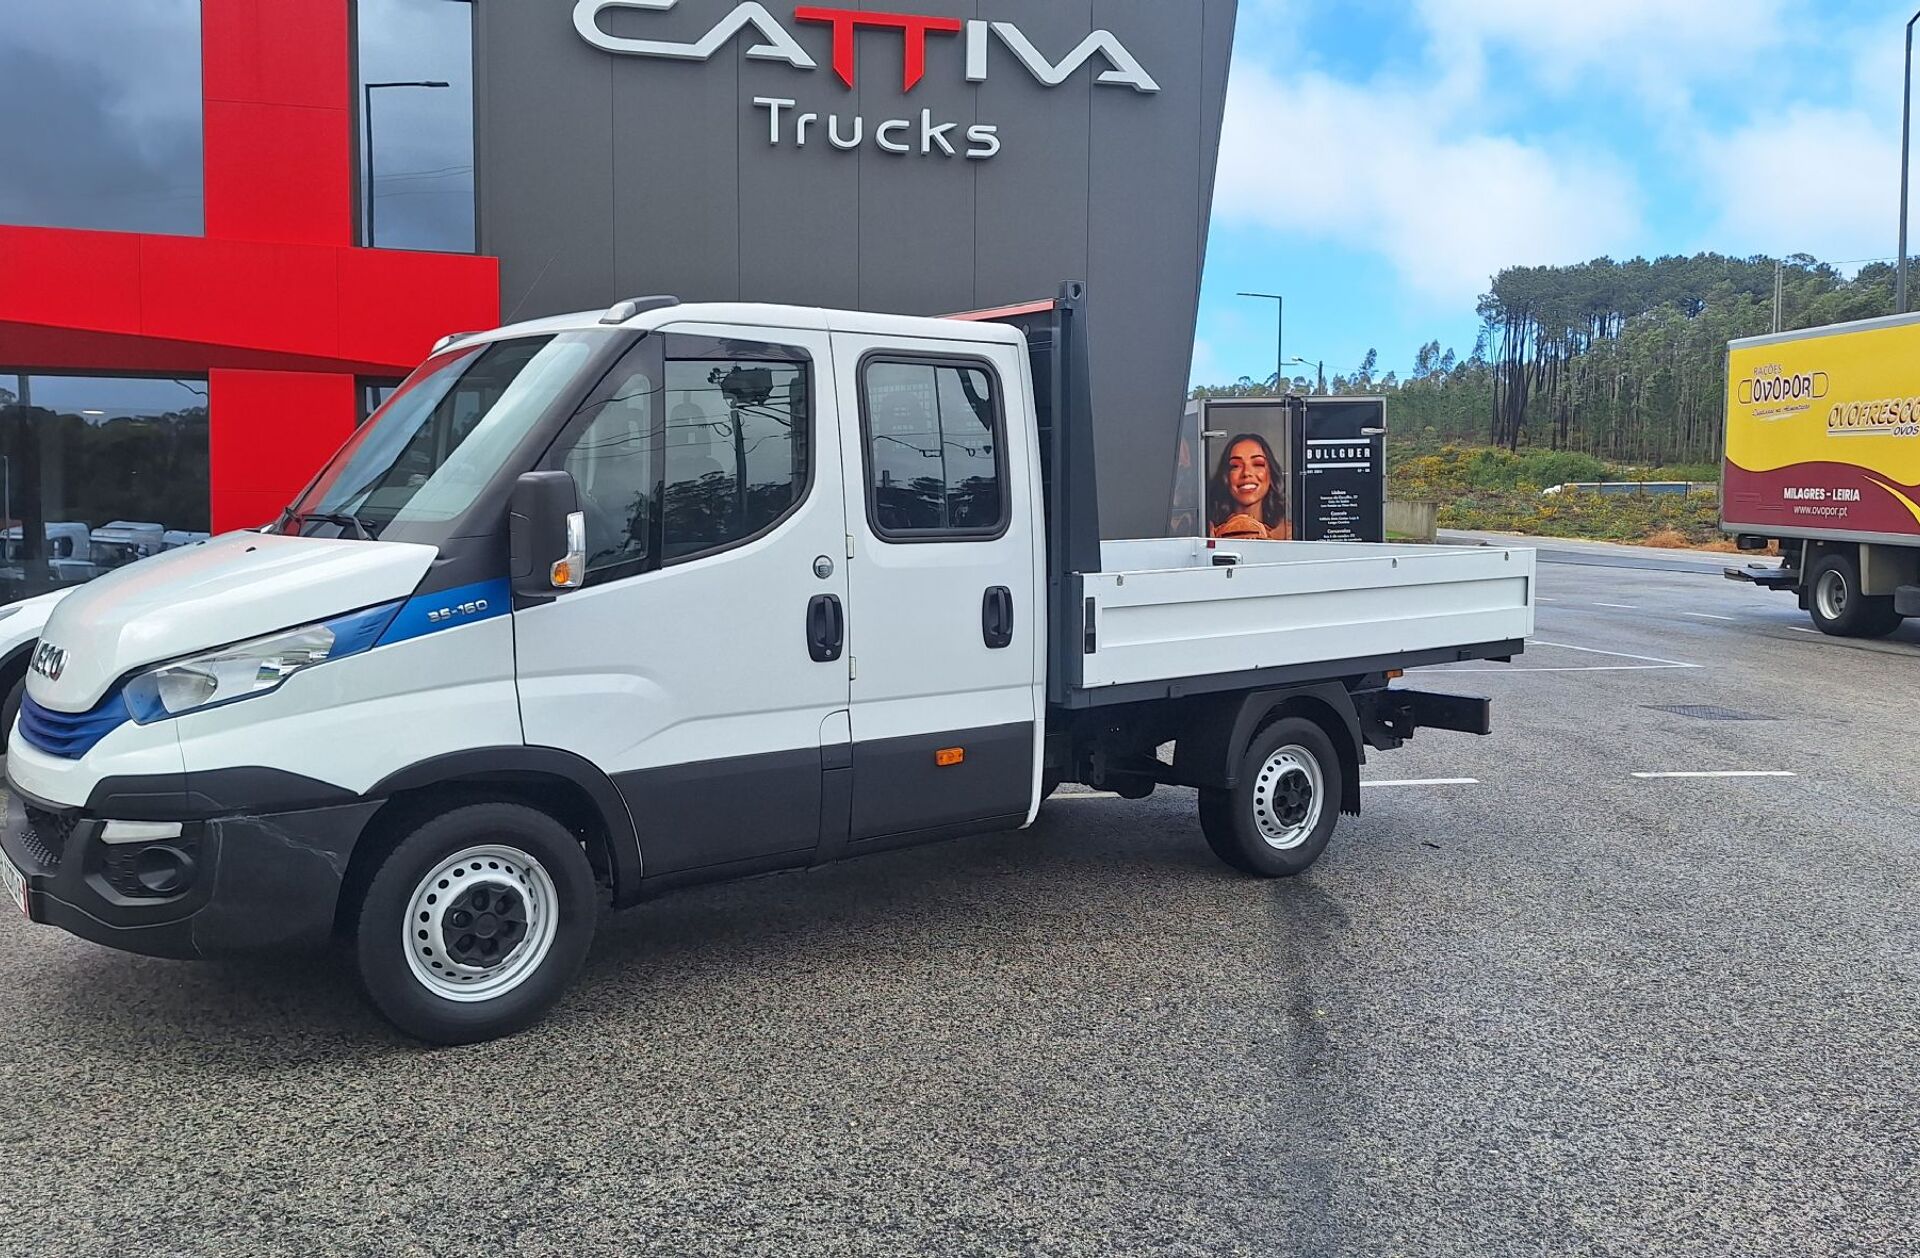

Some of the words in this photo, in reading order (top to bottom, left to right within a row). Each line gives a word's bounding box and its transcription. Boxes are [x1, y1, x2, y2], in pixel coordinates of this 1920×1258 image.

[573, 0, 1161, 92] CATTIVA
[753, 96, 1001, 159] Trucks
[1753, 374, 1811, 402] OVOPOR
[1893, 425, 1920, 436] OVOS
[1307, 448, 1370, 459] BULLGUER
[1784, 488, 1825, 500] MILAGRES
[1832, 489, 1860, 501] LEIRIA
[1794, 505, 1848, 518] www.ovopor.pt
[427, 599, 489, 623] 35-160
